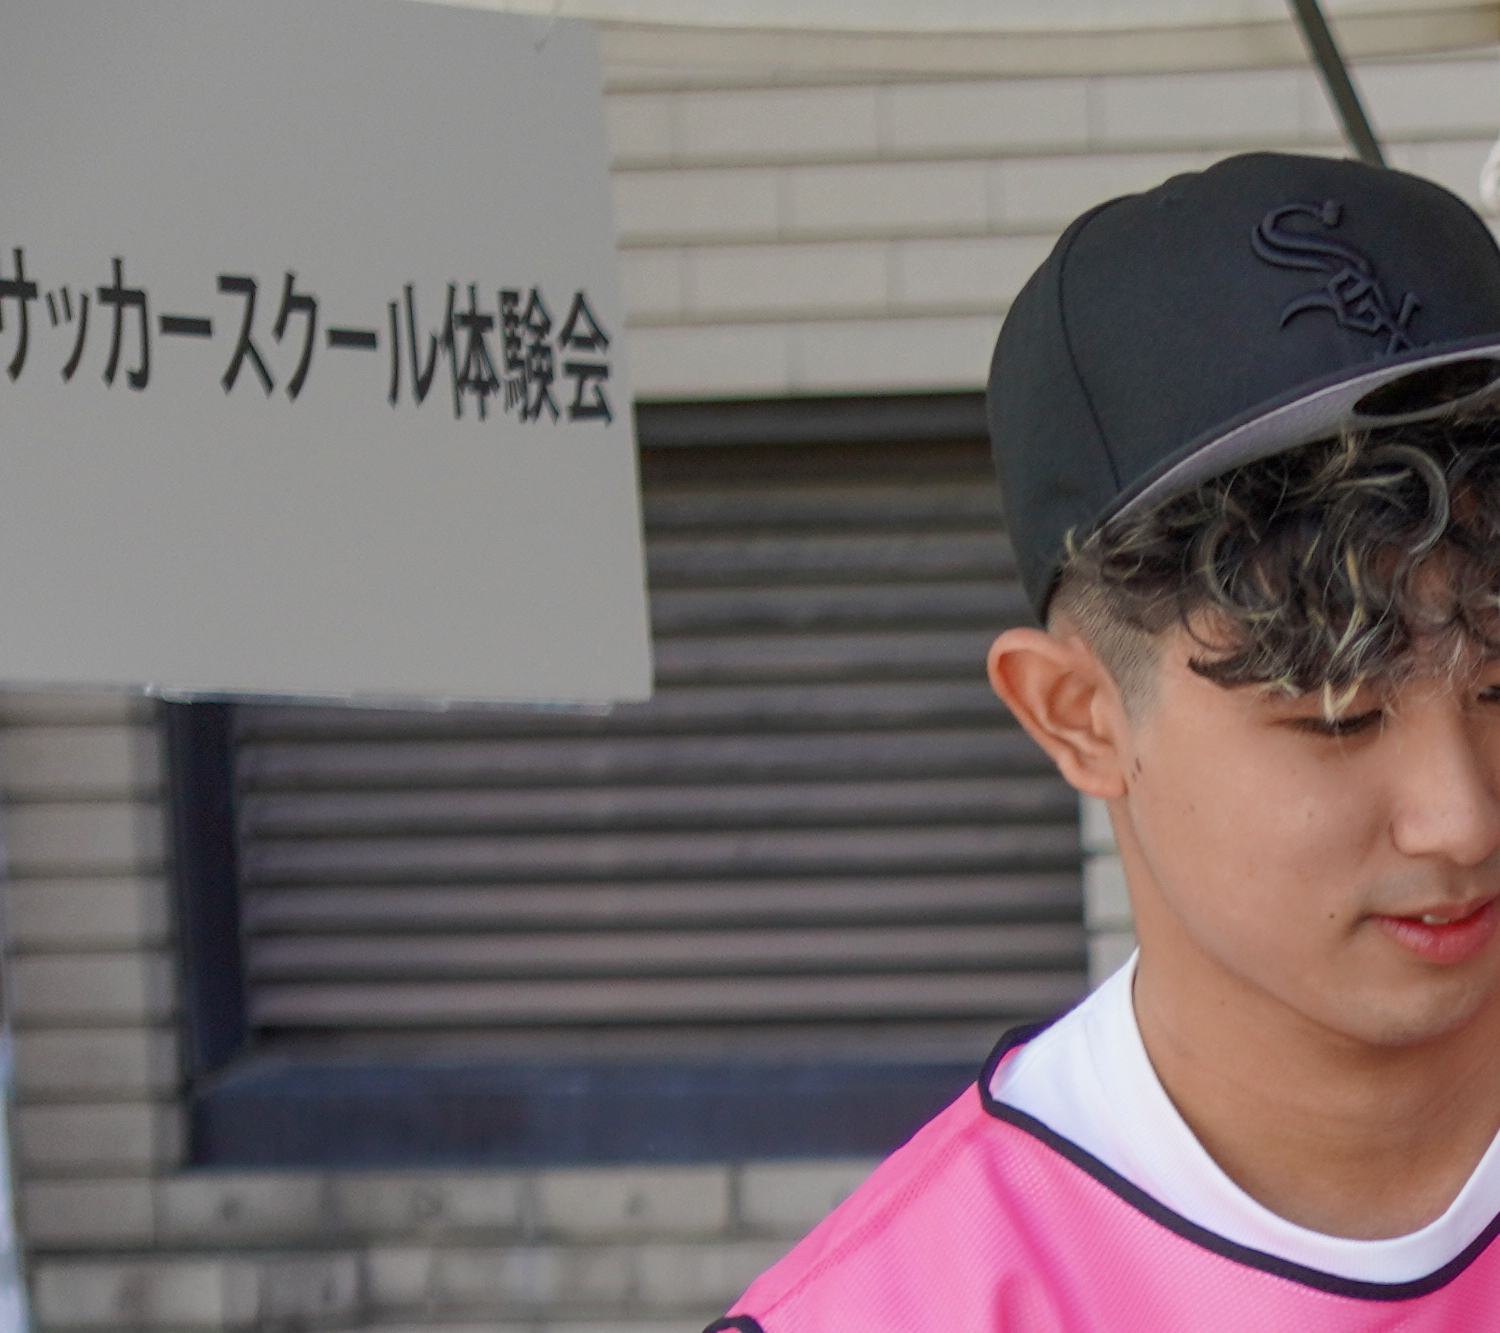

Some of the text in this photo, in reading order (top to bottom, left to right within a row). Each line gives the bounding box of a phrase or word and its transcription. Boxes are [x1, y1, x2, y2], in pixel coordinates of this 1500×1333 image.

[0, 247, 614, 426] サッカースクール体験会
